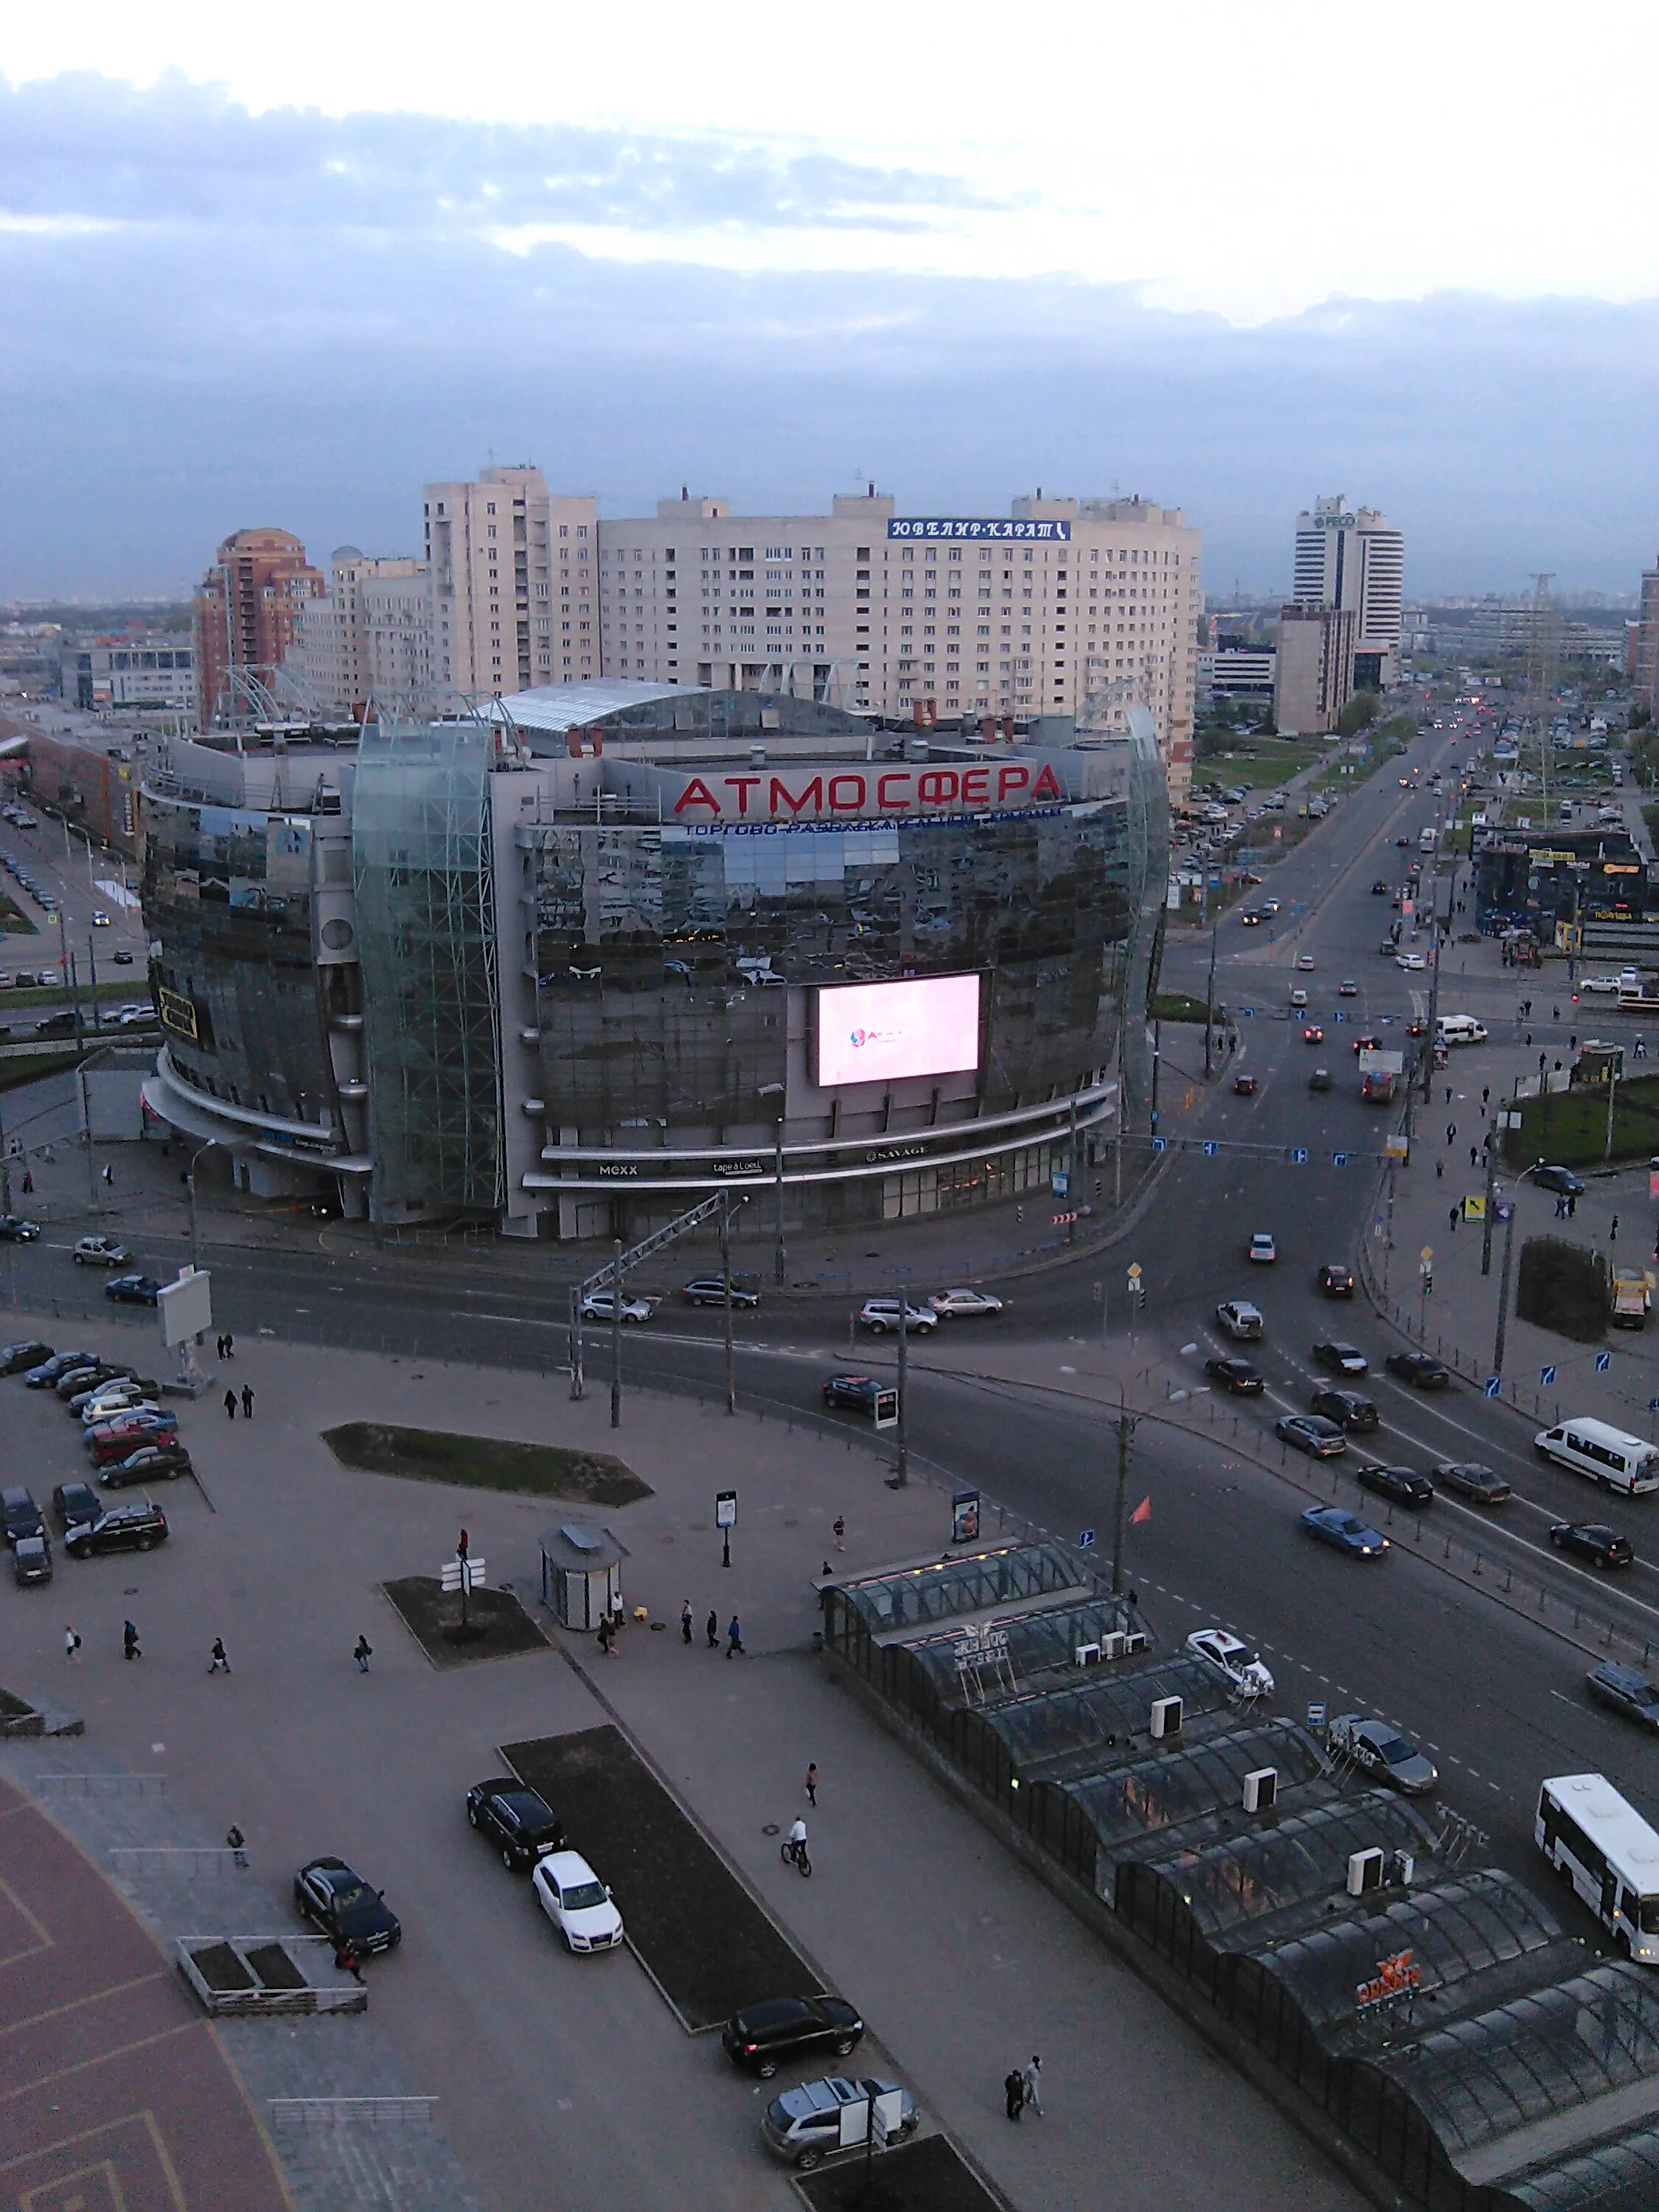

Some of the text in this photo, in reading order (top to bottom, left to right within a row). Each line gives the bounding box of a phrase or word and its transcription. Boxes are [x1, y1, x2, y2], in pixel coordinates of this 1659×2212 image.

[1326, 516, 1355, 526] РЕСО
[674, 764, 1060, 813] АТМОСФЕРА
[878, 1147, 929, 1159] SAVAGE
[713, 1164, 732, 1173] tape
